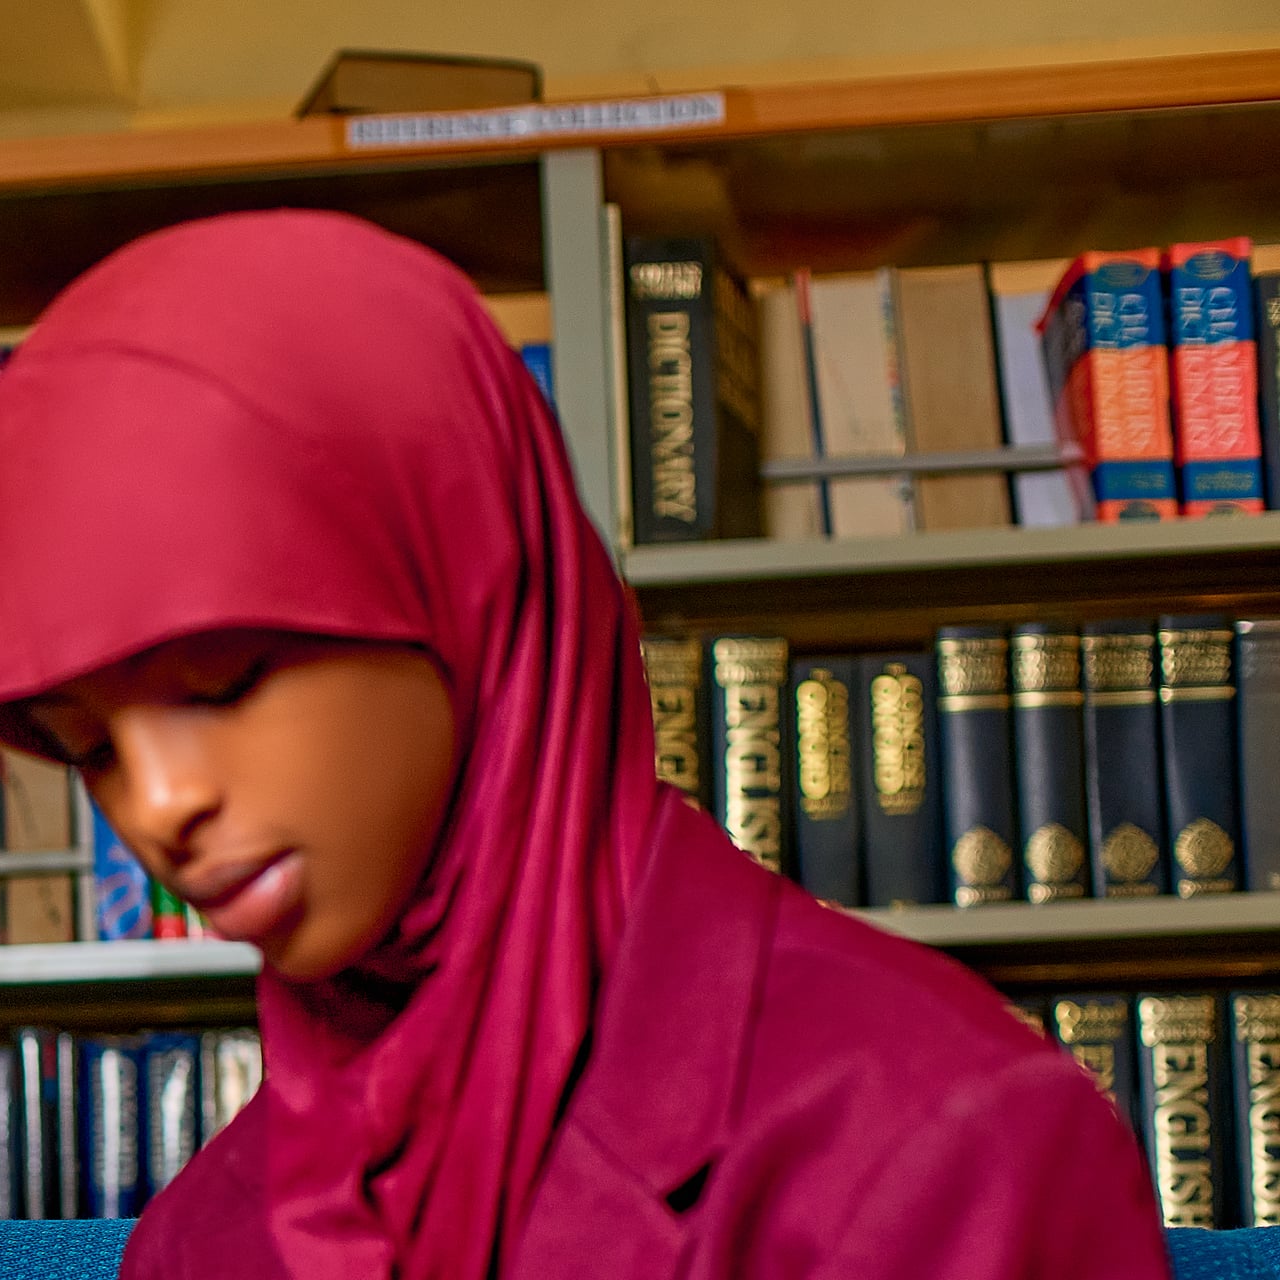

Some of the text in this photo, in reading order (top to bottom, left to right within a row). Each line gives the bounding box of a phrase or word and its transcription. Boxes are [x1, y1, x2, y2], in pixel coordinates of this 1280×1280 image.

[540, 95, 719, 131] COLLECTION
[646, 312, 697, 522] DICTIONARY
[1152, 1043, 1214, 1230] ENGLISH
